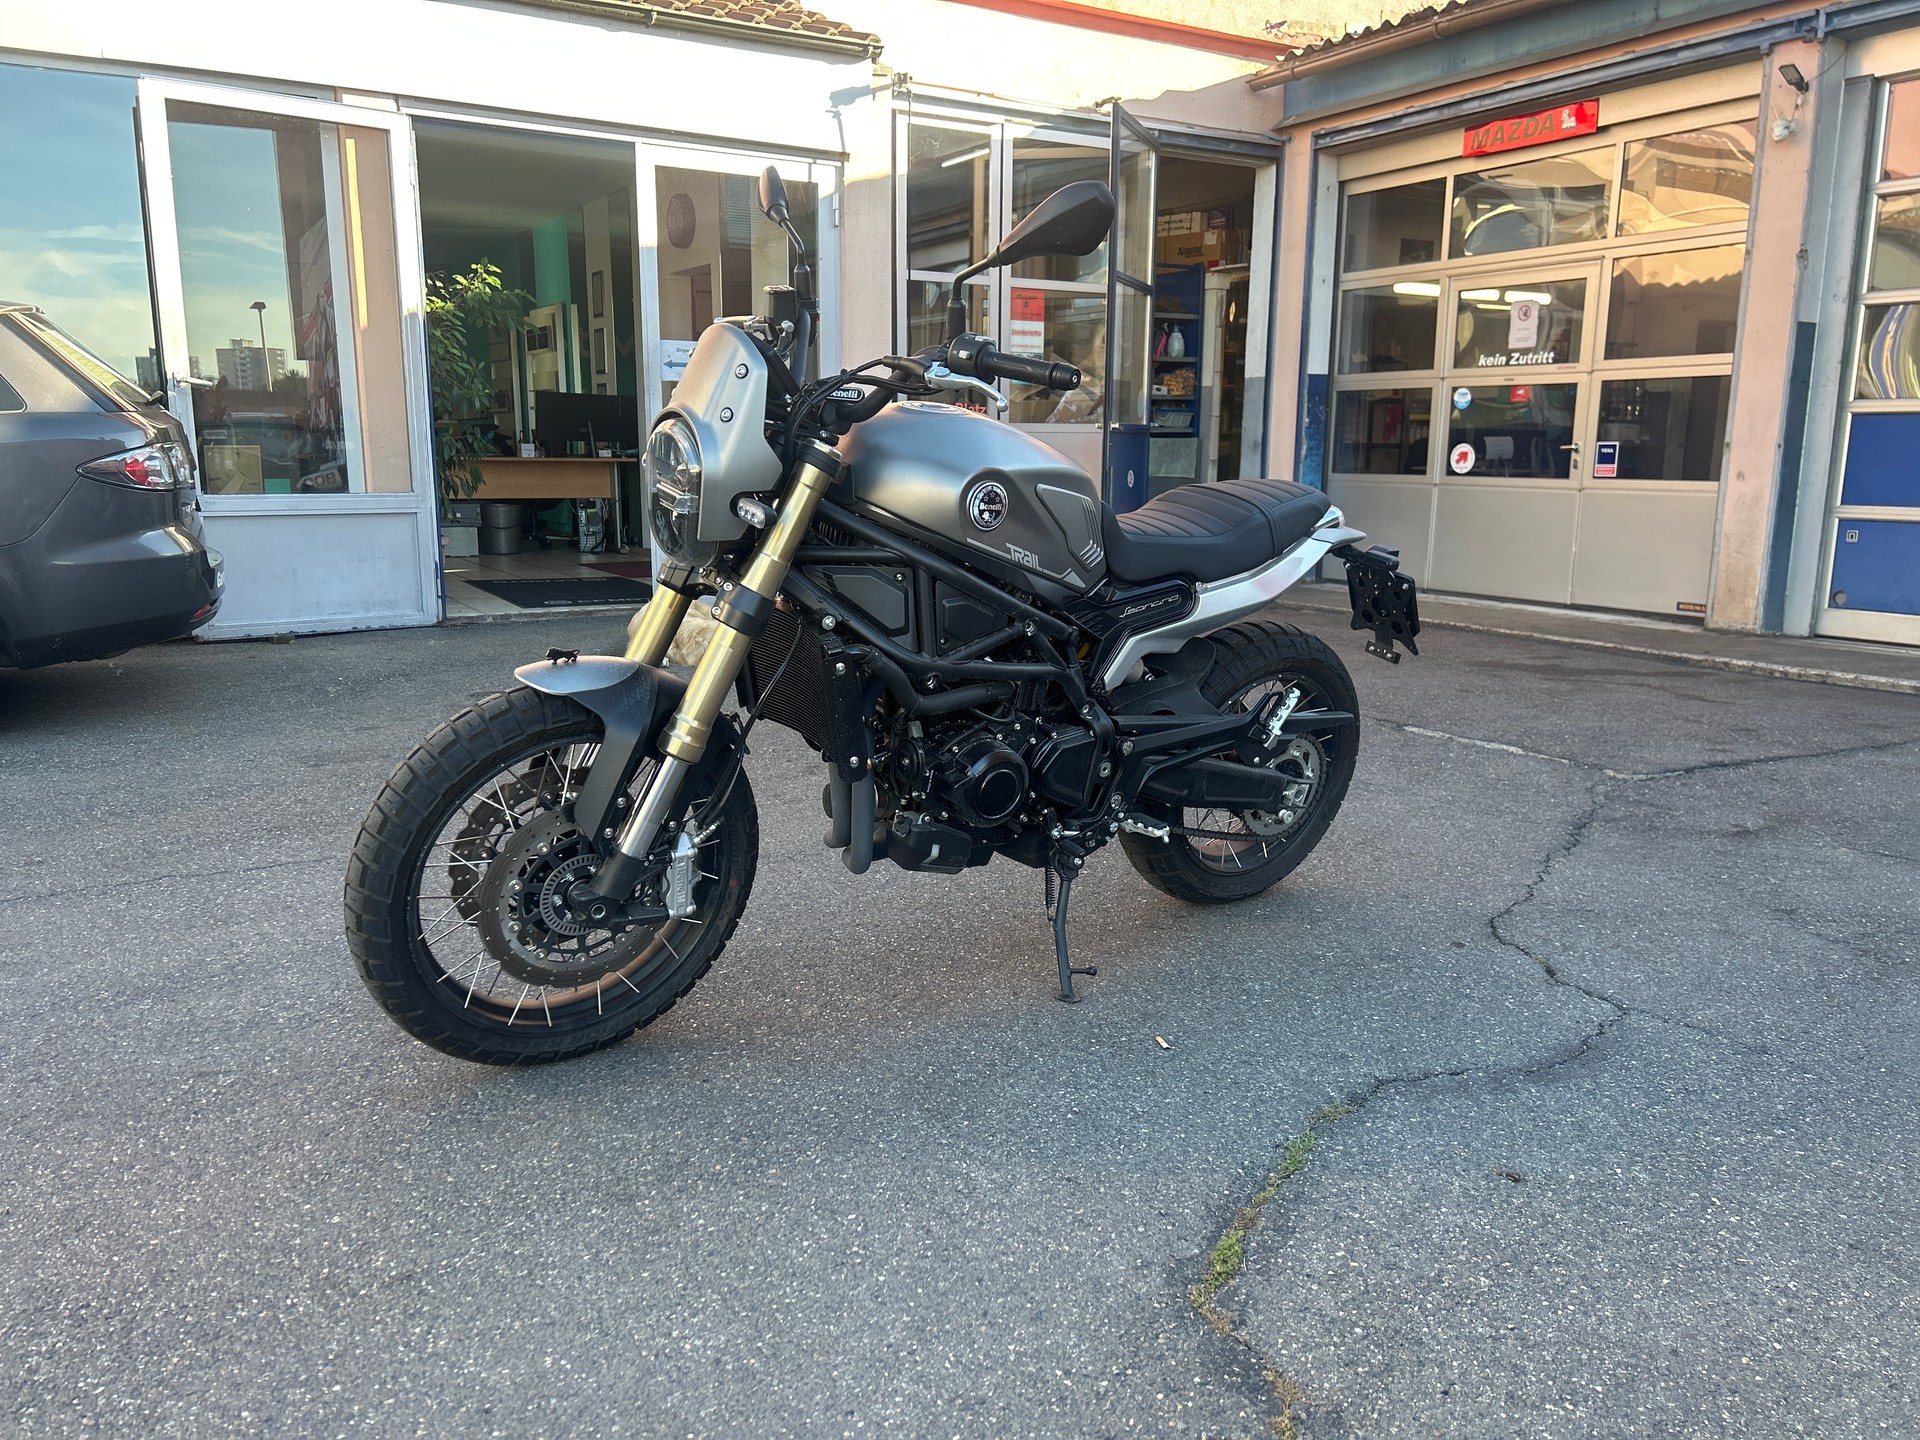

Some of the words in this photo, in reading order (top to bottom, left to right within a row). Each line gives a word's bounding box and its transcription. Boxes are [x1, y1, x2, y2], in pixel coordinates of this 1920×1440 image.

[1470, 113, 1554, 151] MAZDA
[1478, 353, 1507, 367] kein
[1509, 350, 1555, 366] Zutritt
[979, 502, 1003, 511] Benelli
